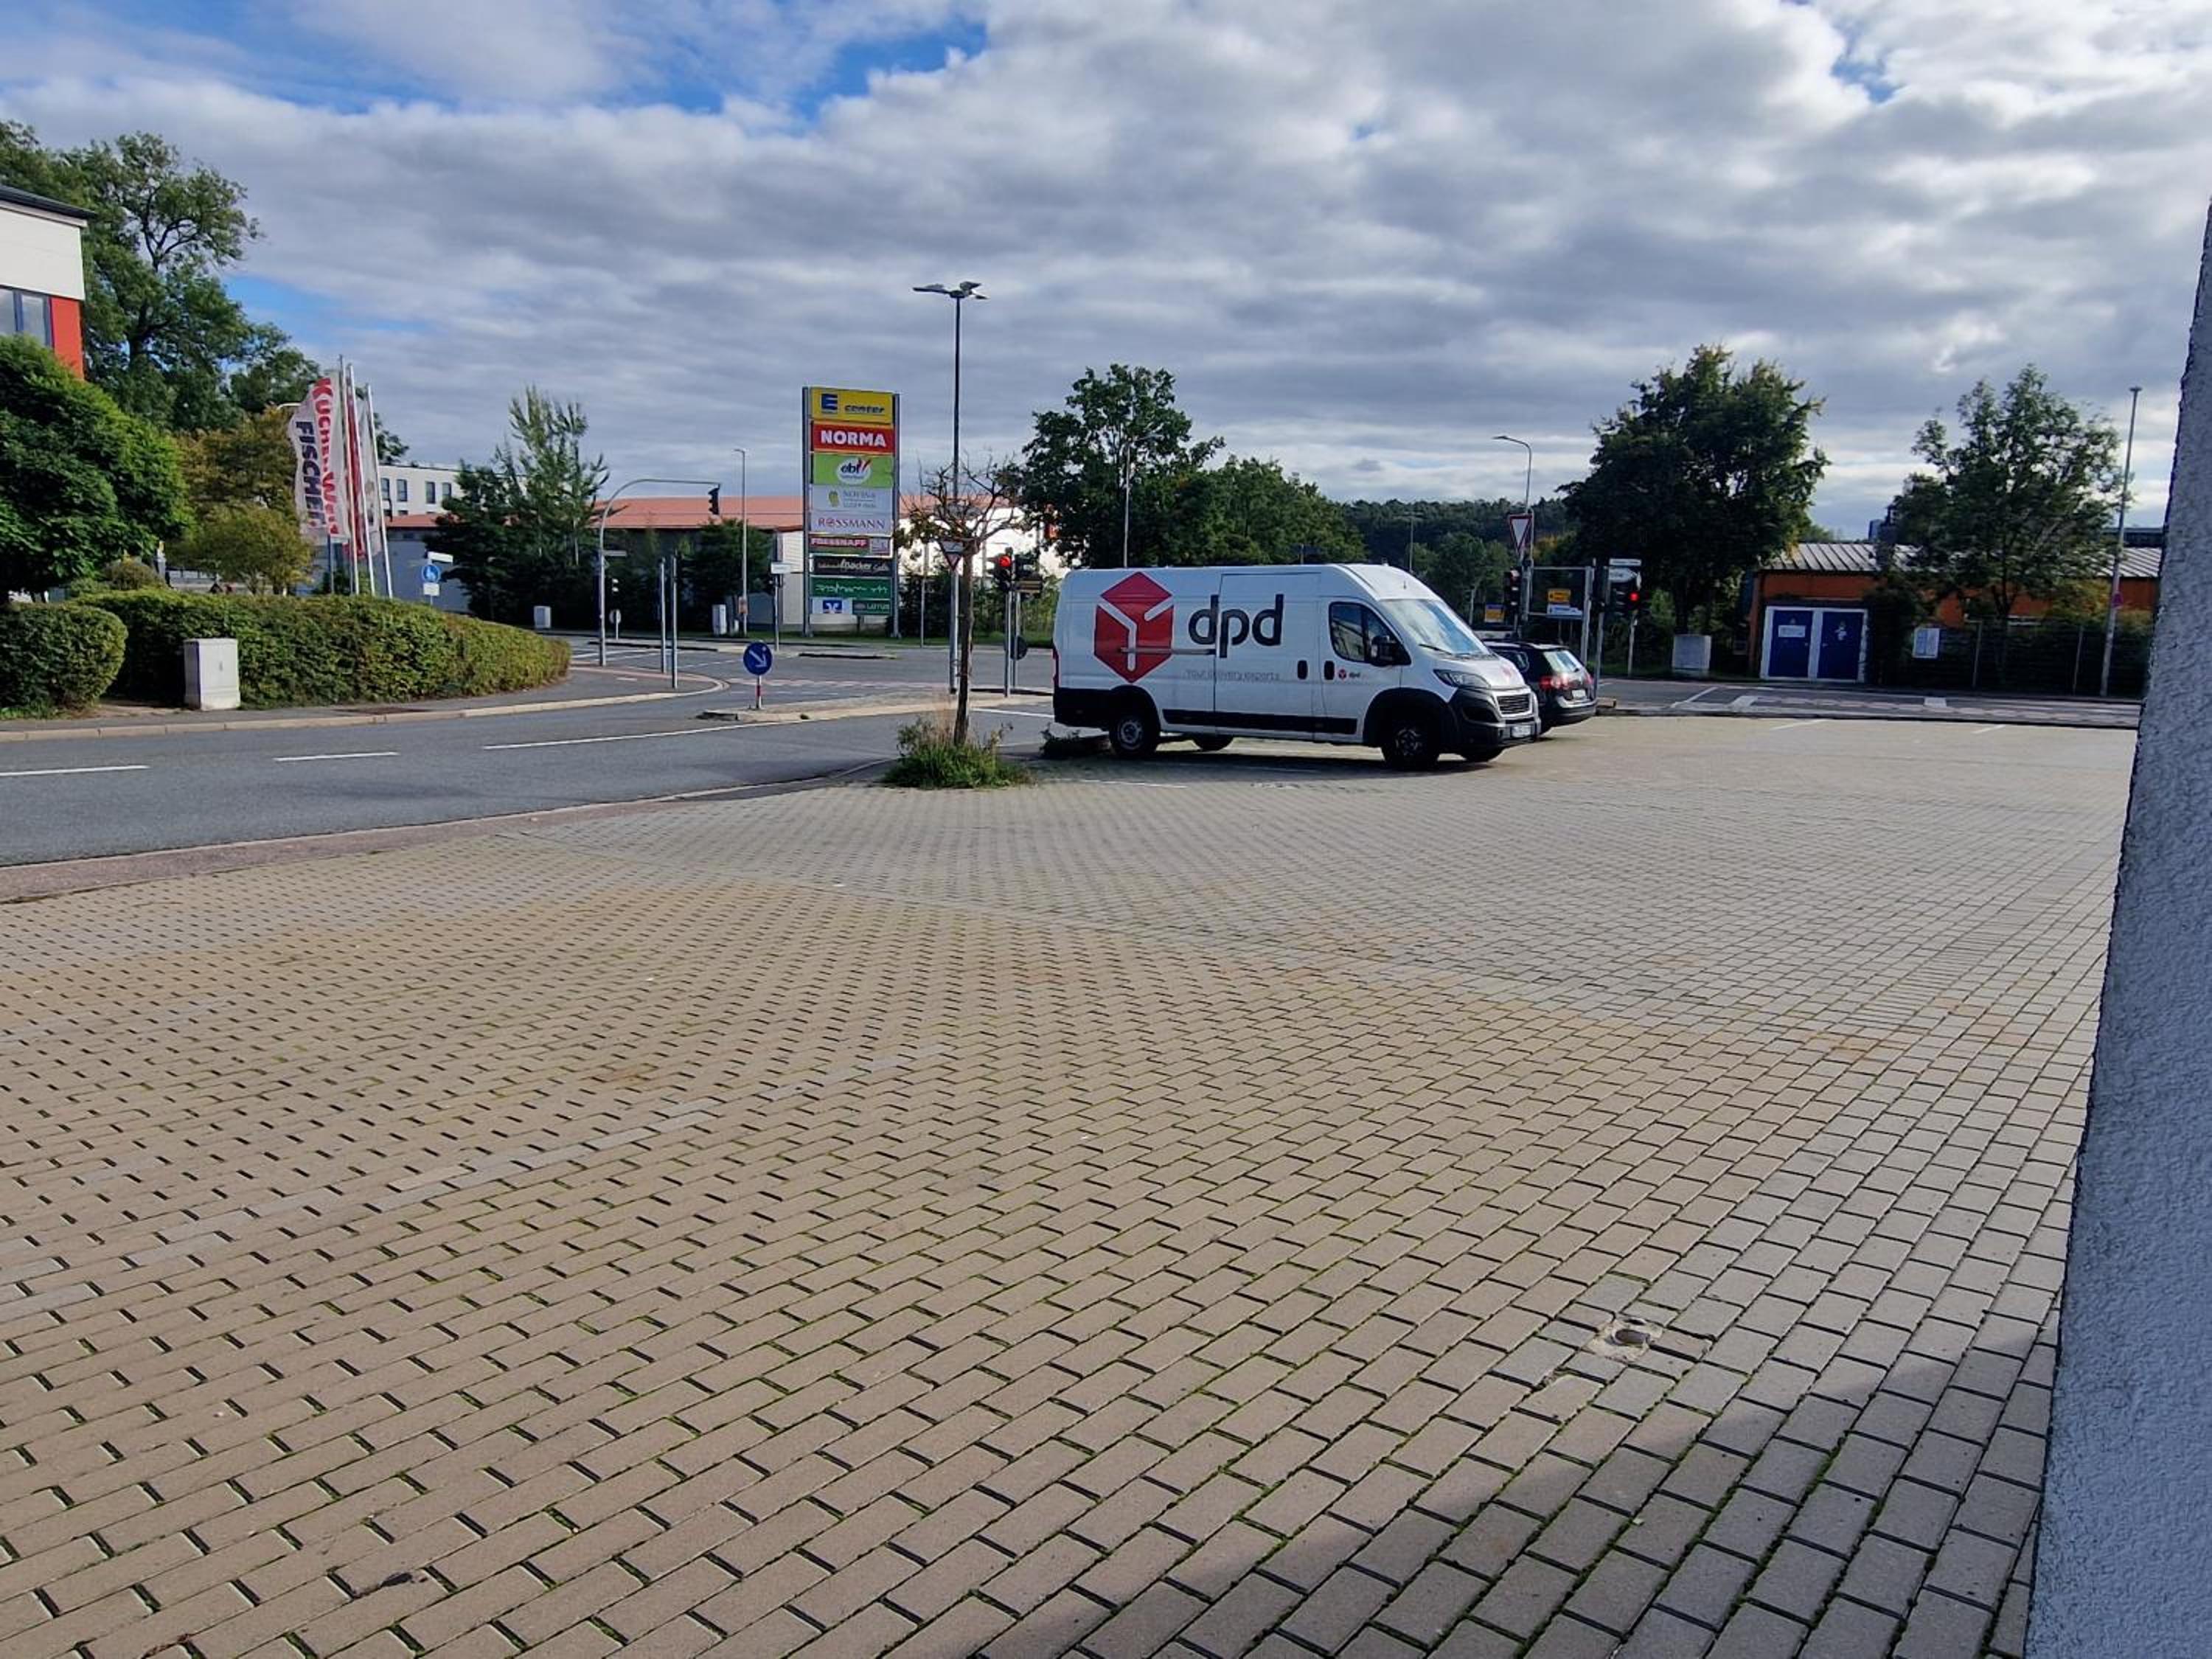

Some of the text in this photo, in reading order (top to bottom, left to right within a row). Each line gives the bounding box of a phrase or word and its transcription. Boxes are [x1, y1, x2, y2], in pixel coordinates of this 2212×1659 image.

[844, 405, 885, 414] center
[821, 430, 886, 448] NORMA
[296, 421, 327, 526] FISCHER
[818, 518, 885, 529] ROSSMANN
[1188, 594, 1284, 658] dpd
